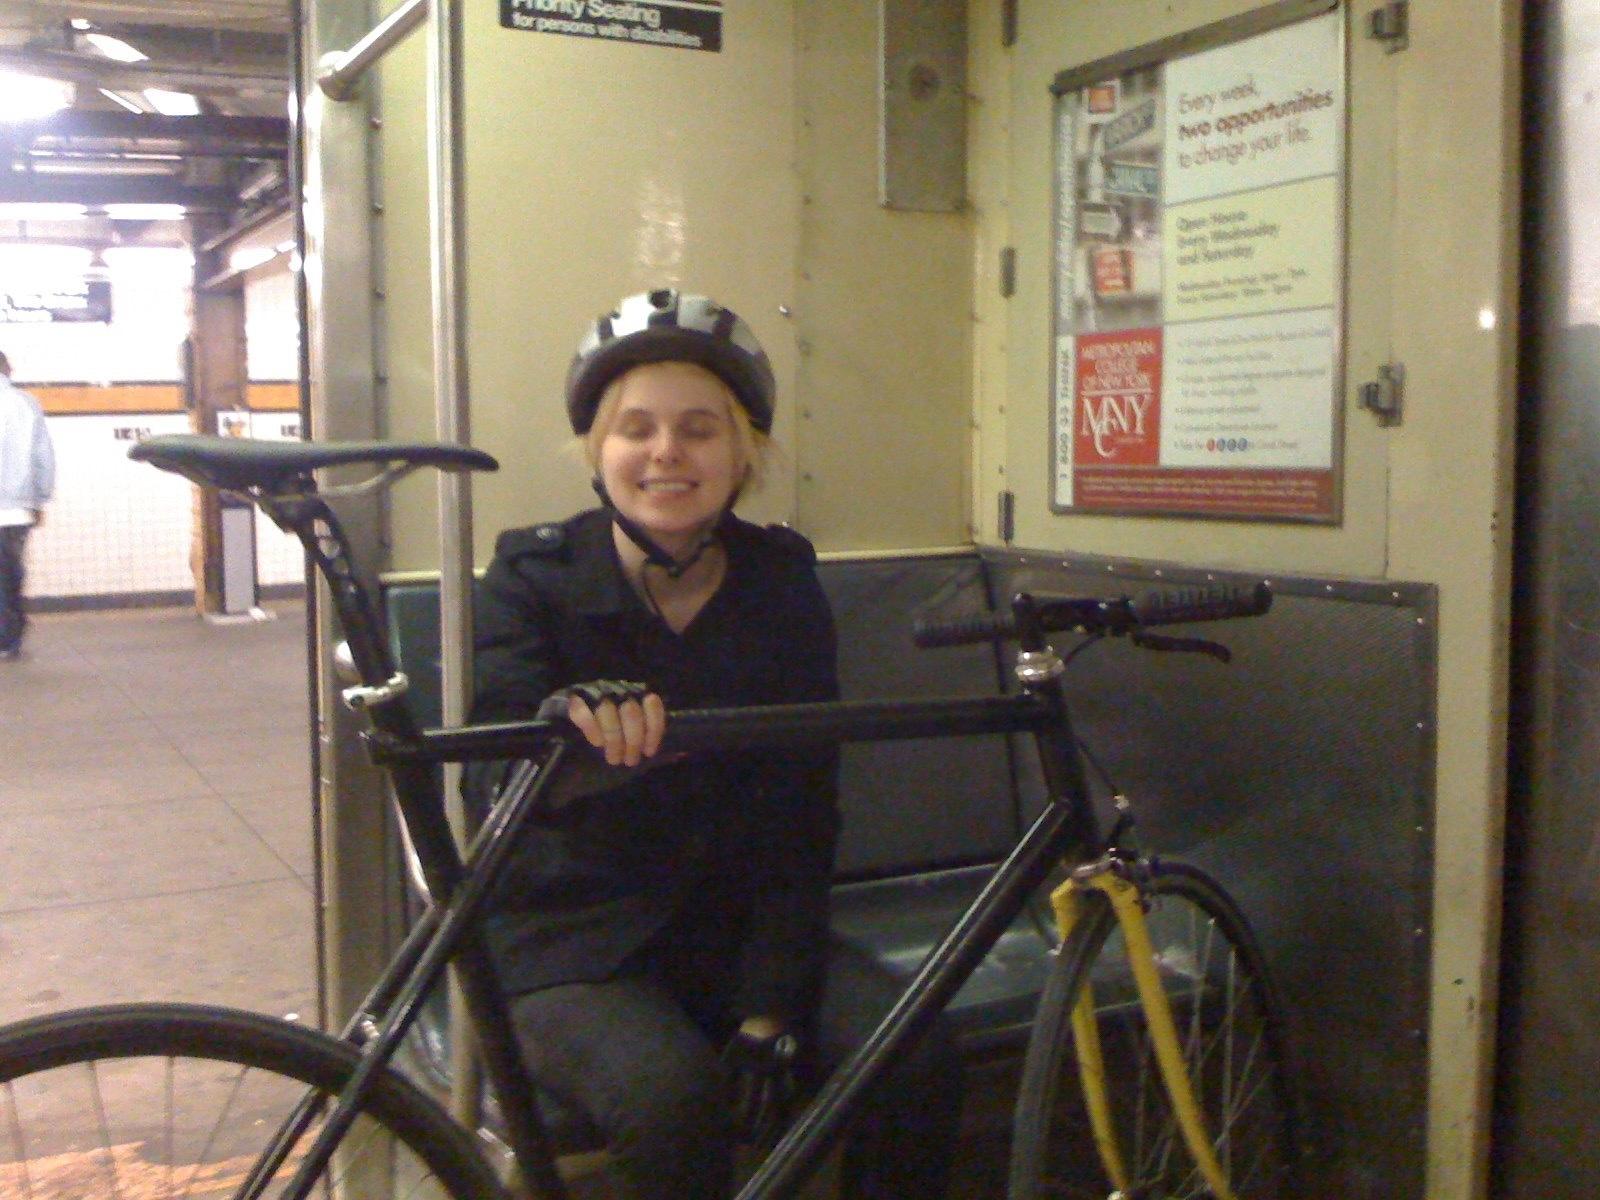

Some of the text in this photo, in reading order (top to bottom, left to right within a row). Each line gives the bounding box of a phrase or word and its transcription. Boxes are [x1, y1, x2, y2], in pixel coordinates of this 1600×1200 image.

[512, 11, 534, 27] for
[536, 17, 596, 34] persons
[598, 23, 629, 38] with
[587, 1, 661, 29] Seating
[1178, 92, 1216, 114] Every
[1178, 88, 1334, 141] two opportunities
[1193, 141, 1248, 165] change
